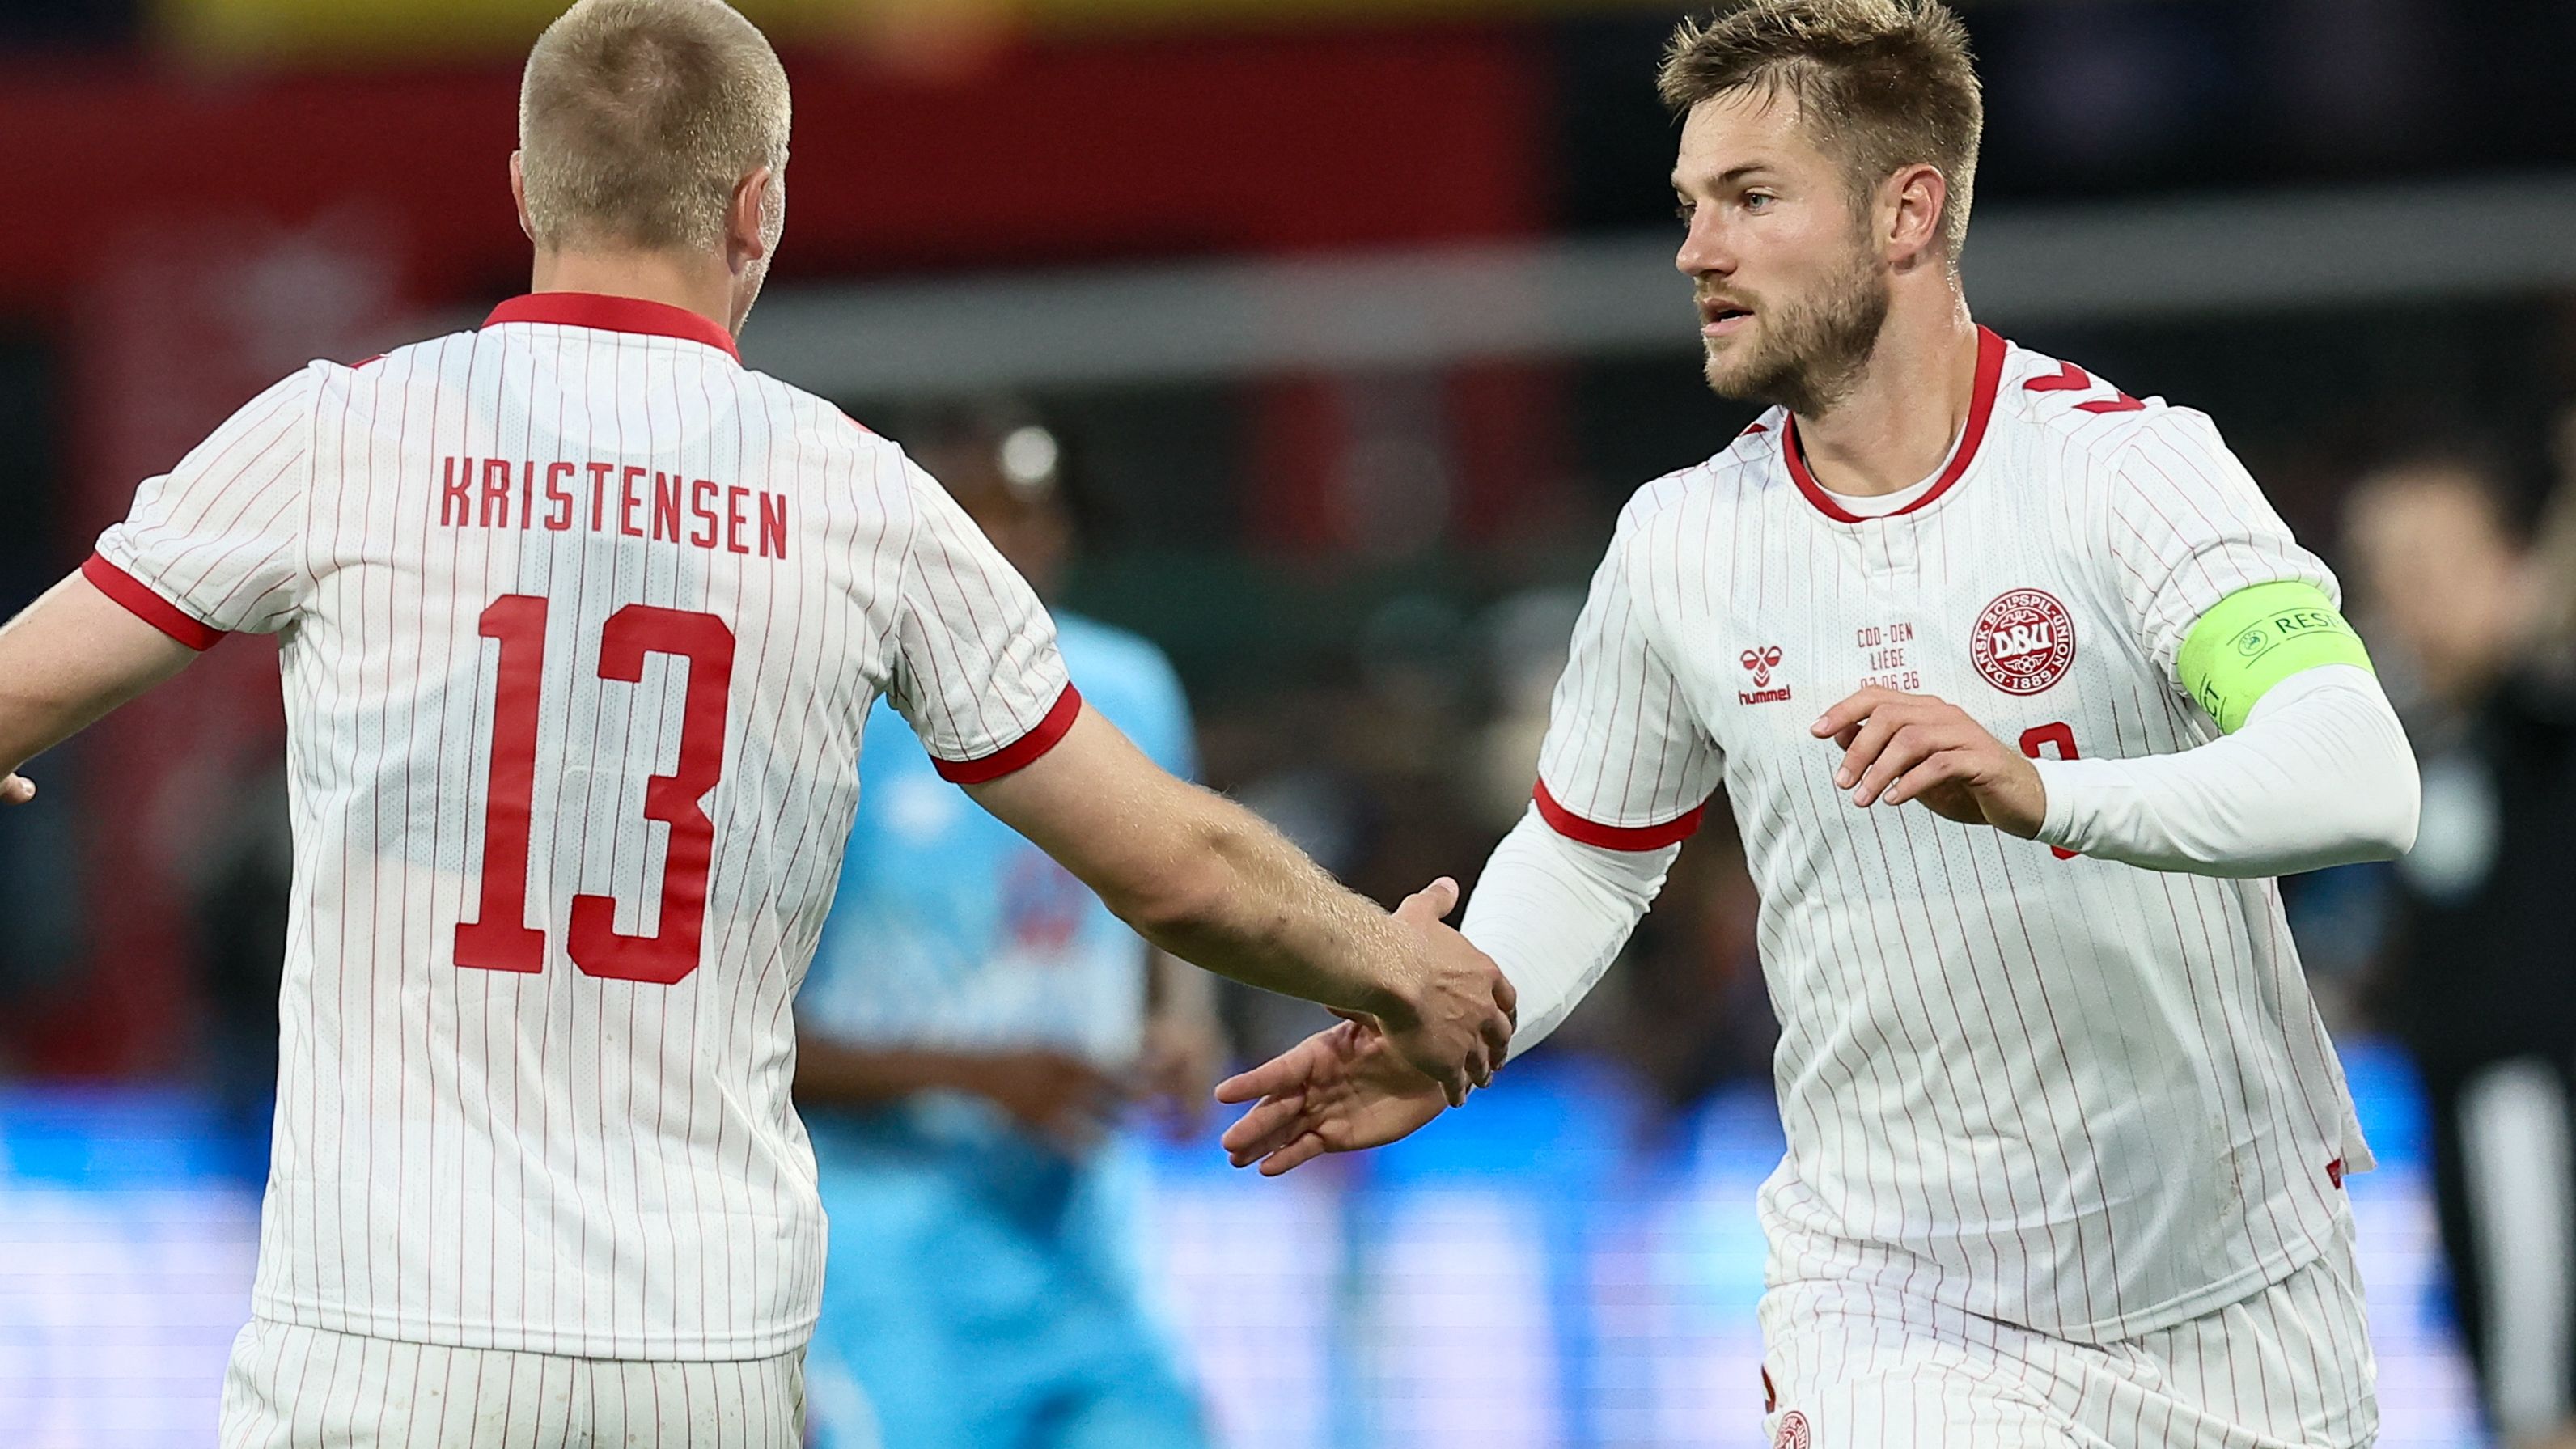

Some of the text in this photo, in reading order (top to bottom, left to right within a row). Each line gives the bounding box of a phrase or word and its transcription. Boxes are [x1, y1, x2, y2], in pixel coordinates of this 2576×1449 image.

[440, 455, 786, 560] KRISTENSEN
[1870, 647, 1906, 671] LIÈGE
[1976, 629, 2006, 684] DANSK
[2012, 669, 2052, 689] 1889
[1993, 621, 2053, 659] DBU
[1738, 684, 1791, 706] hummel
[452, 593, 736, 985] 13
